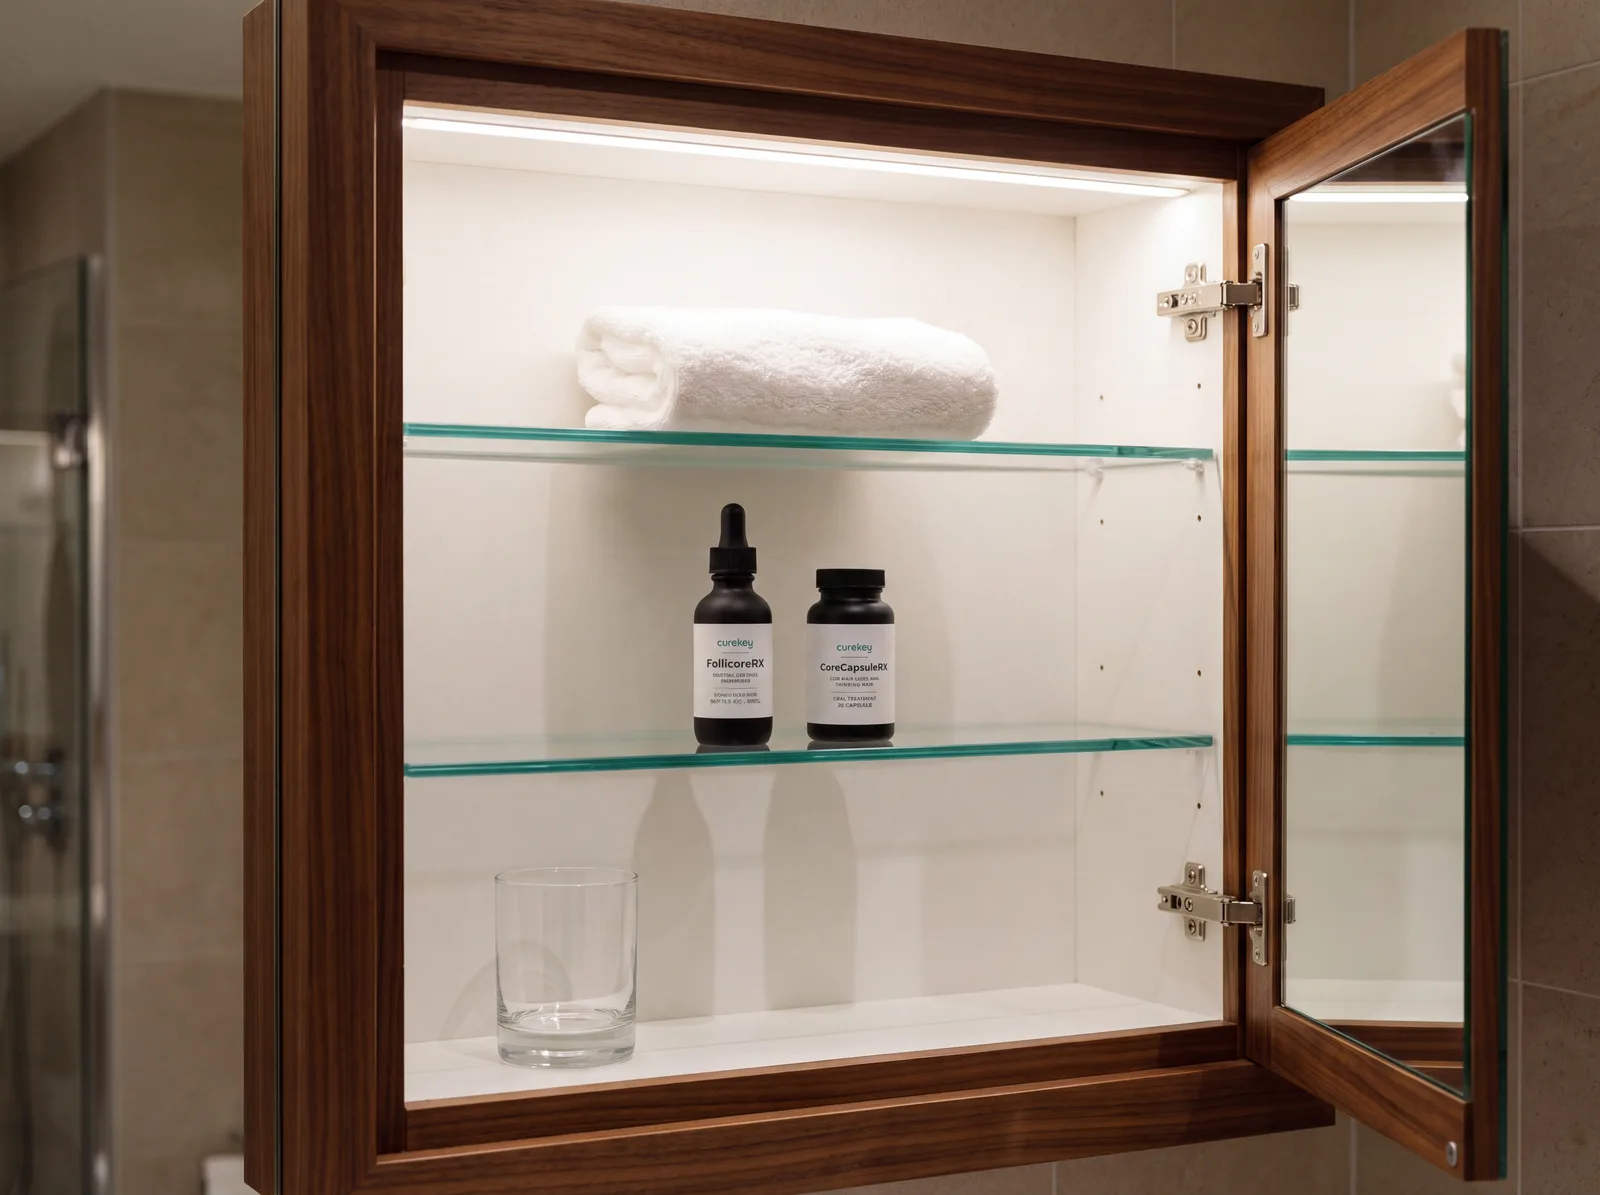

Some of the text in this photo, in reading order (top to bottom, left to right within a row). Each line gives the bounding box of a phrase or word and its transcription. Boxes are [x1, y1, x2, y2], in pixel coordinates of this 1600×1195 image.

[717, 638, 754, 649] curekey
[836, 643, 873, 654] curekey
[706, 658, 765, 669] FollicoreRX
[819, 662, 888, 673] CoreCapsuleRX
